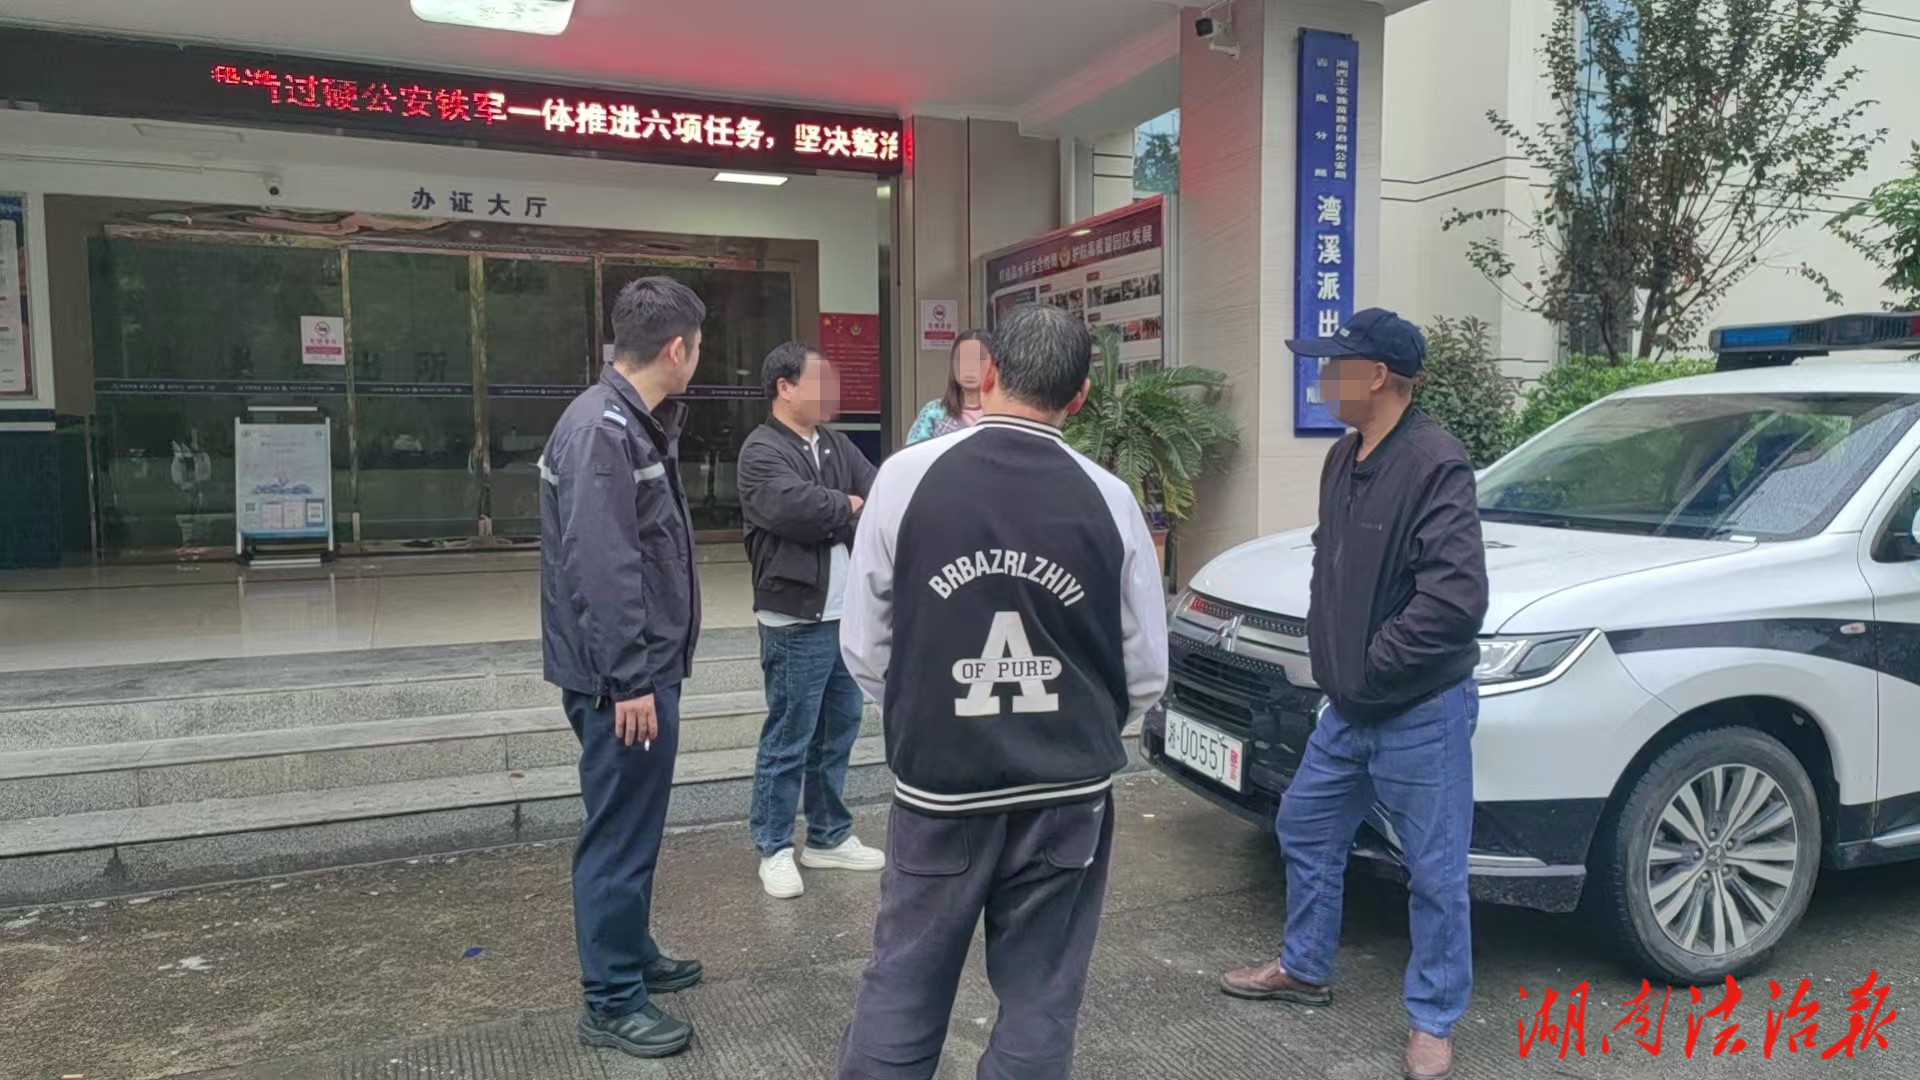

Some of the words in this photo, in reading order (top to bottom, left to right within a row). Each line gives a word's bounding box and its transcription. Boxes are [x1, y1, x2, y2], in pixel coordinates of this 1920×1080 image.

[411, 187, 547, 218] 办证大厅
[928, 549, 1085, 607] BRBAZRLZHIYI
[954, 611, 1059, 716] A
[962, 662, 986, 679] OF
[998, 660, 1053, 678] PURE
